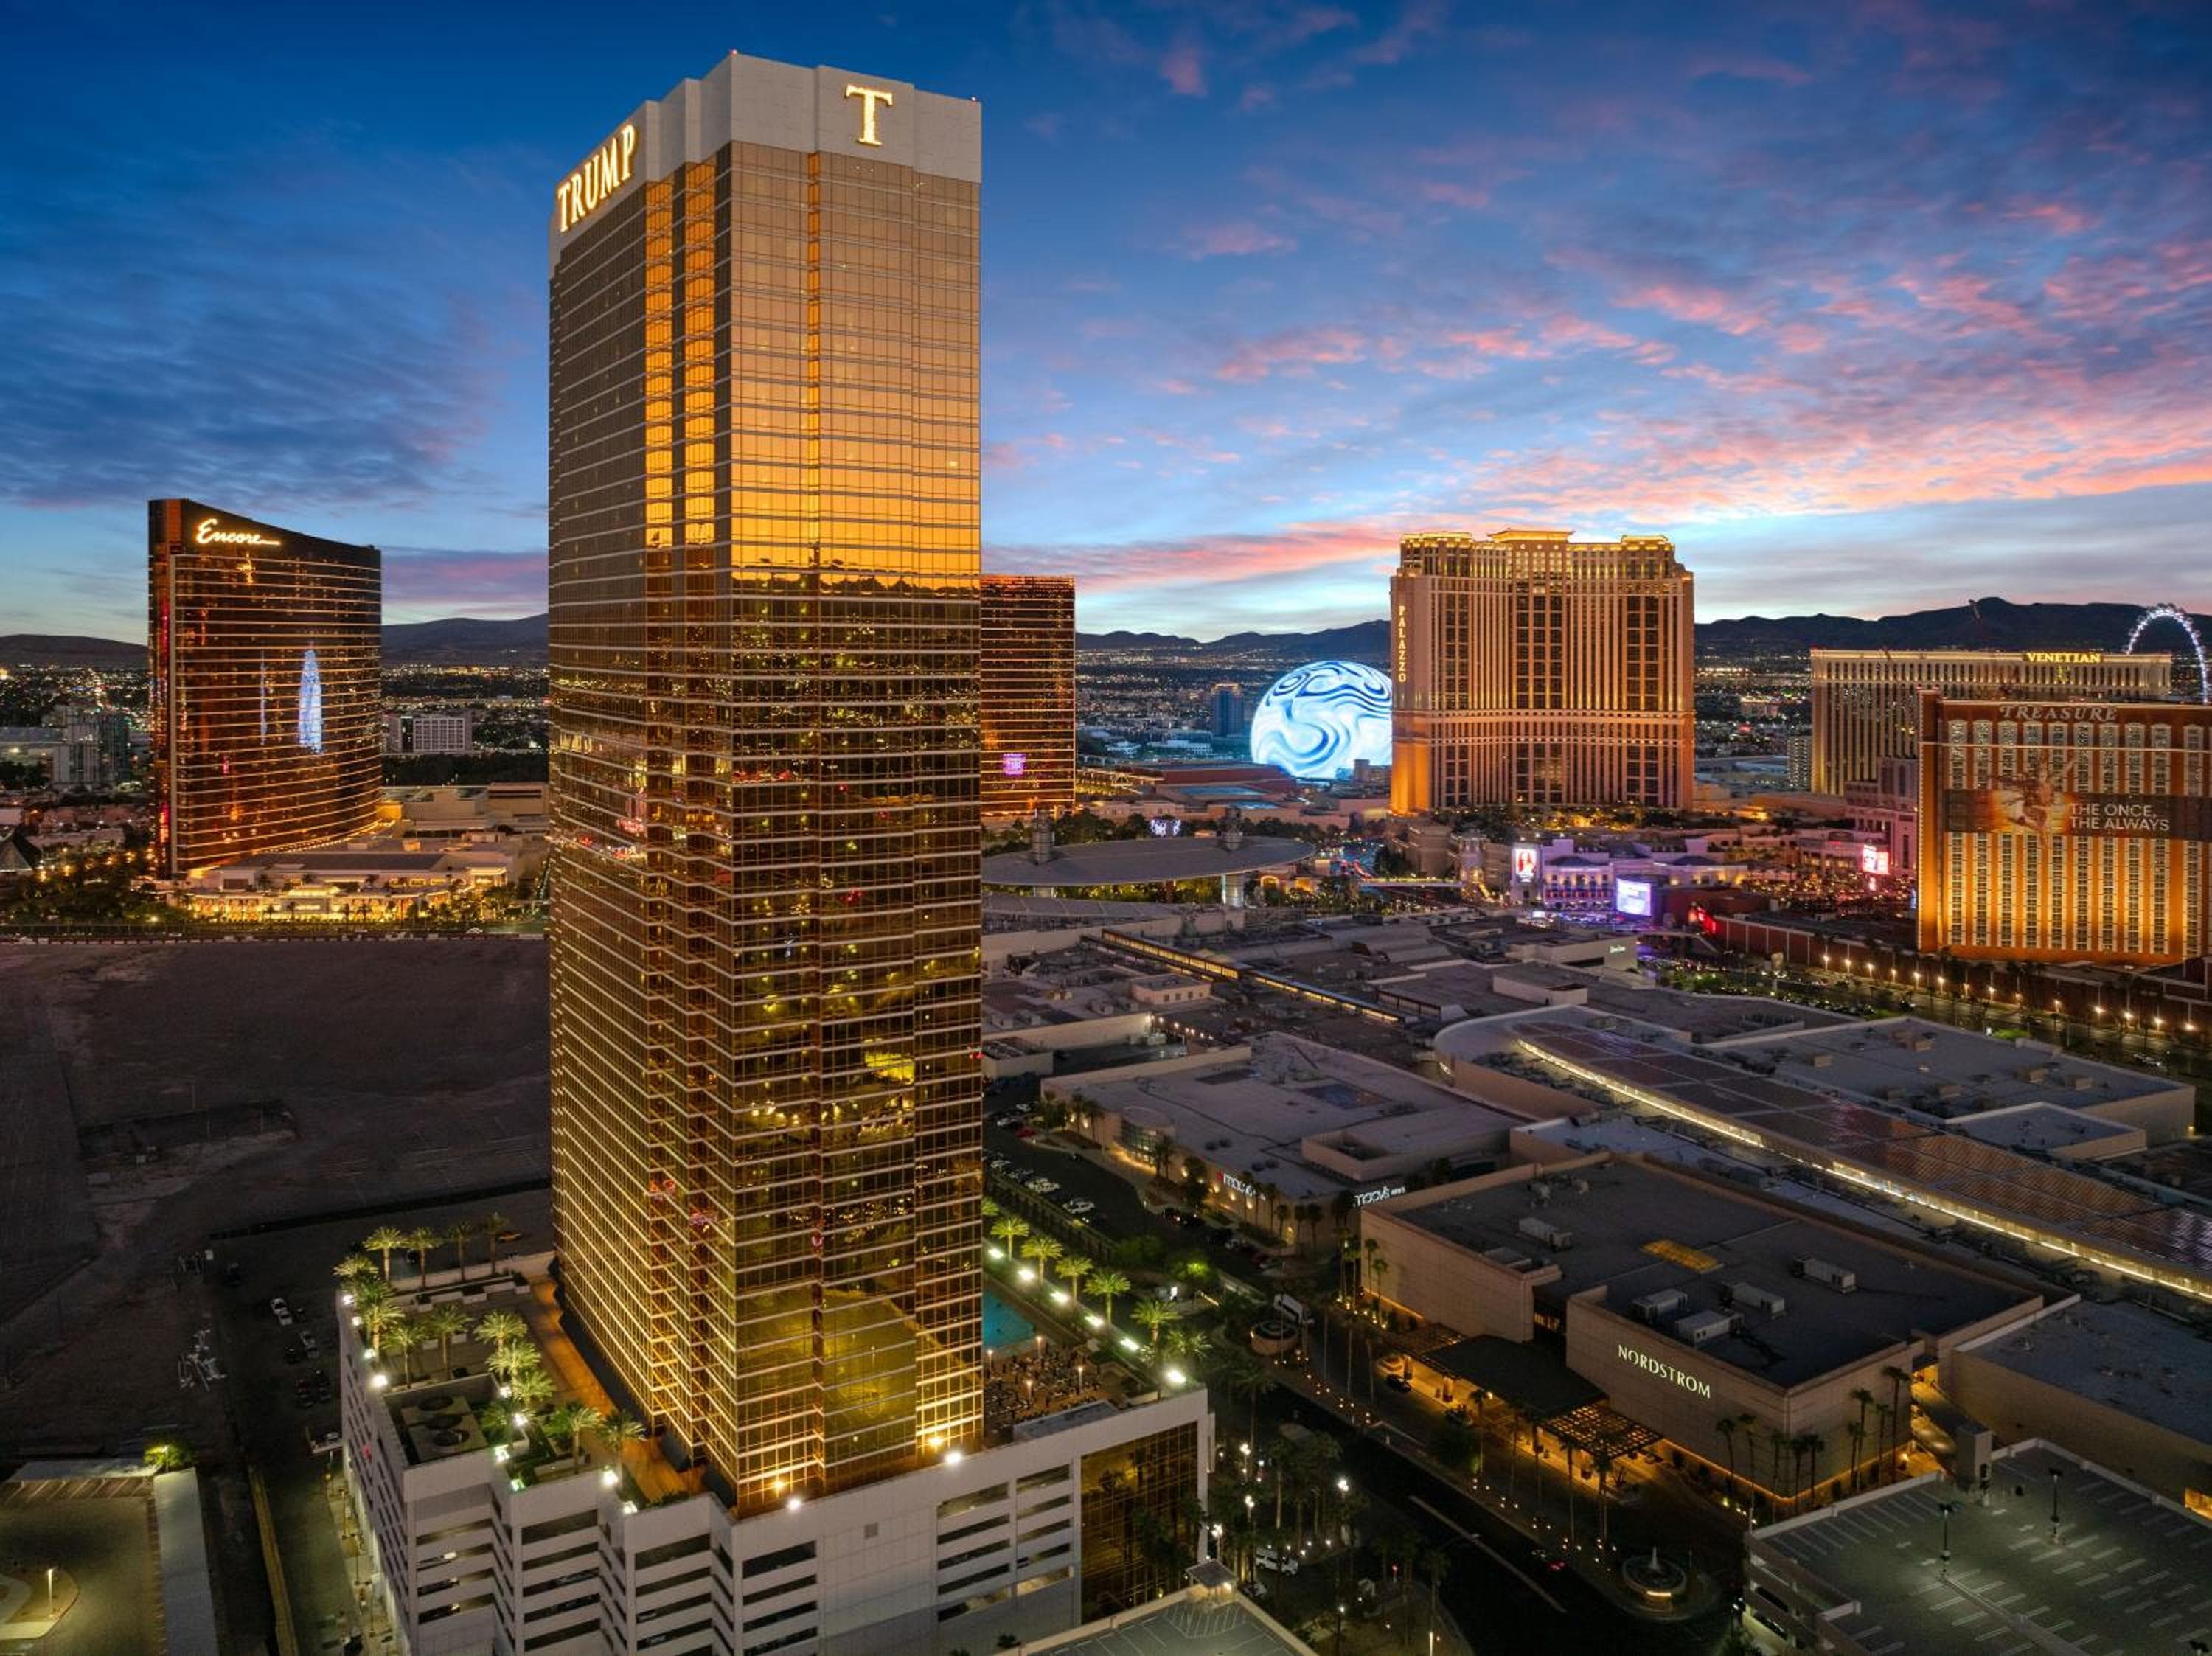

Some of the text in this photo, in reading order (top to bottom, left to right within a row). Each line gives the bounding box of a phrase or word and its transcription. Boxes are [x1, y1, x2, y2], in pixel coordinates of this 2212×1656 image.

[846, 84, 894, 146] T
[557, 125, 636, 232] TRUMP
[196, 518, 281, 545] Encore
[1398, 605, 1406, 682] PALAZZO
[2027, 653, 2101, 663] VENETIAN
[1999, 704, 2118, 723] TREASURE
[2070, 803, 2157, 818] THE ONCE,
[2070, 816, 2171, 831] THE ALWAYS
[1618, 1344, 1711, 1399] NORDSTROM
